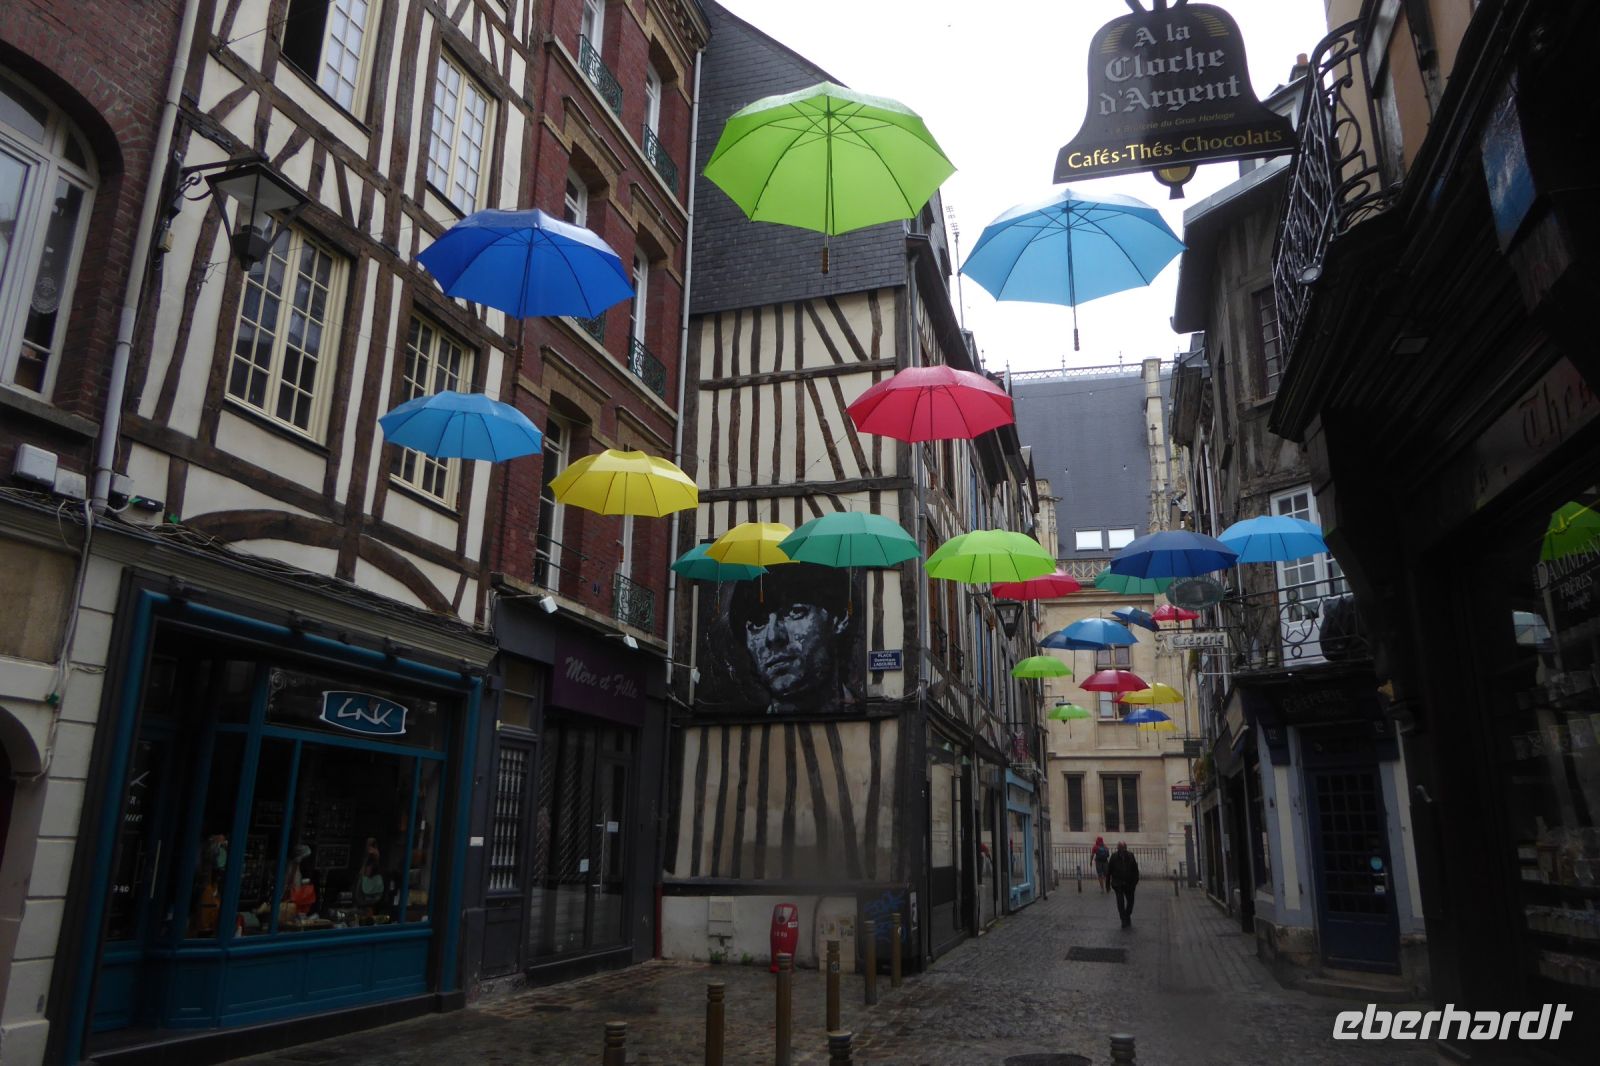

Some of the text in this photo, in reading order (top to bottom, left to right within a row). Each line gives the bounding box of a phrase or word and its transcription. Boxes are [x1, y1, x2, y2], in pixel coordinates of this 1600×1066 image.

[1133, 23, 1191, 48] A la
[1104, 46, 1225, 83] Cloche
[1098, 75, 1242, 117] d'Argent
[1174, 117, 1197, 127] Gros
[1198, 111, 1236, 123] Horloge
[1067, 128, 1283, 170] Cafés-Thés-Chocolats
[564, 655, 640, 699] Mère et Fille
